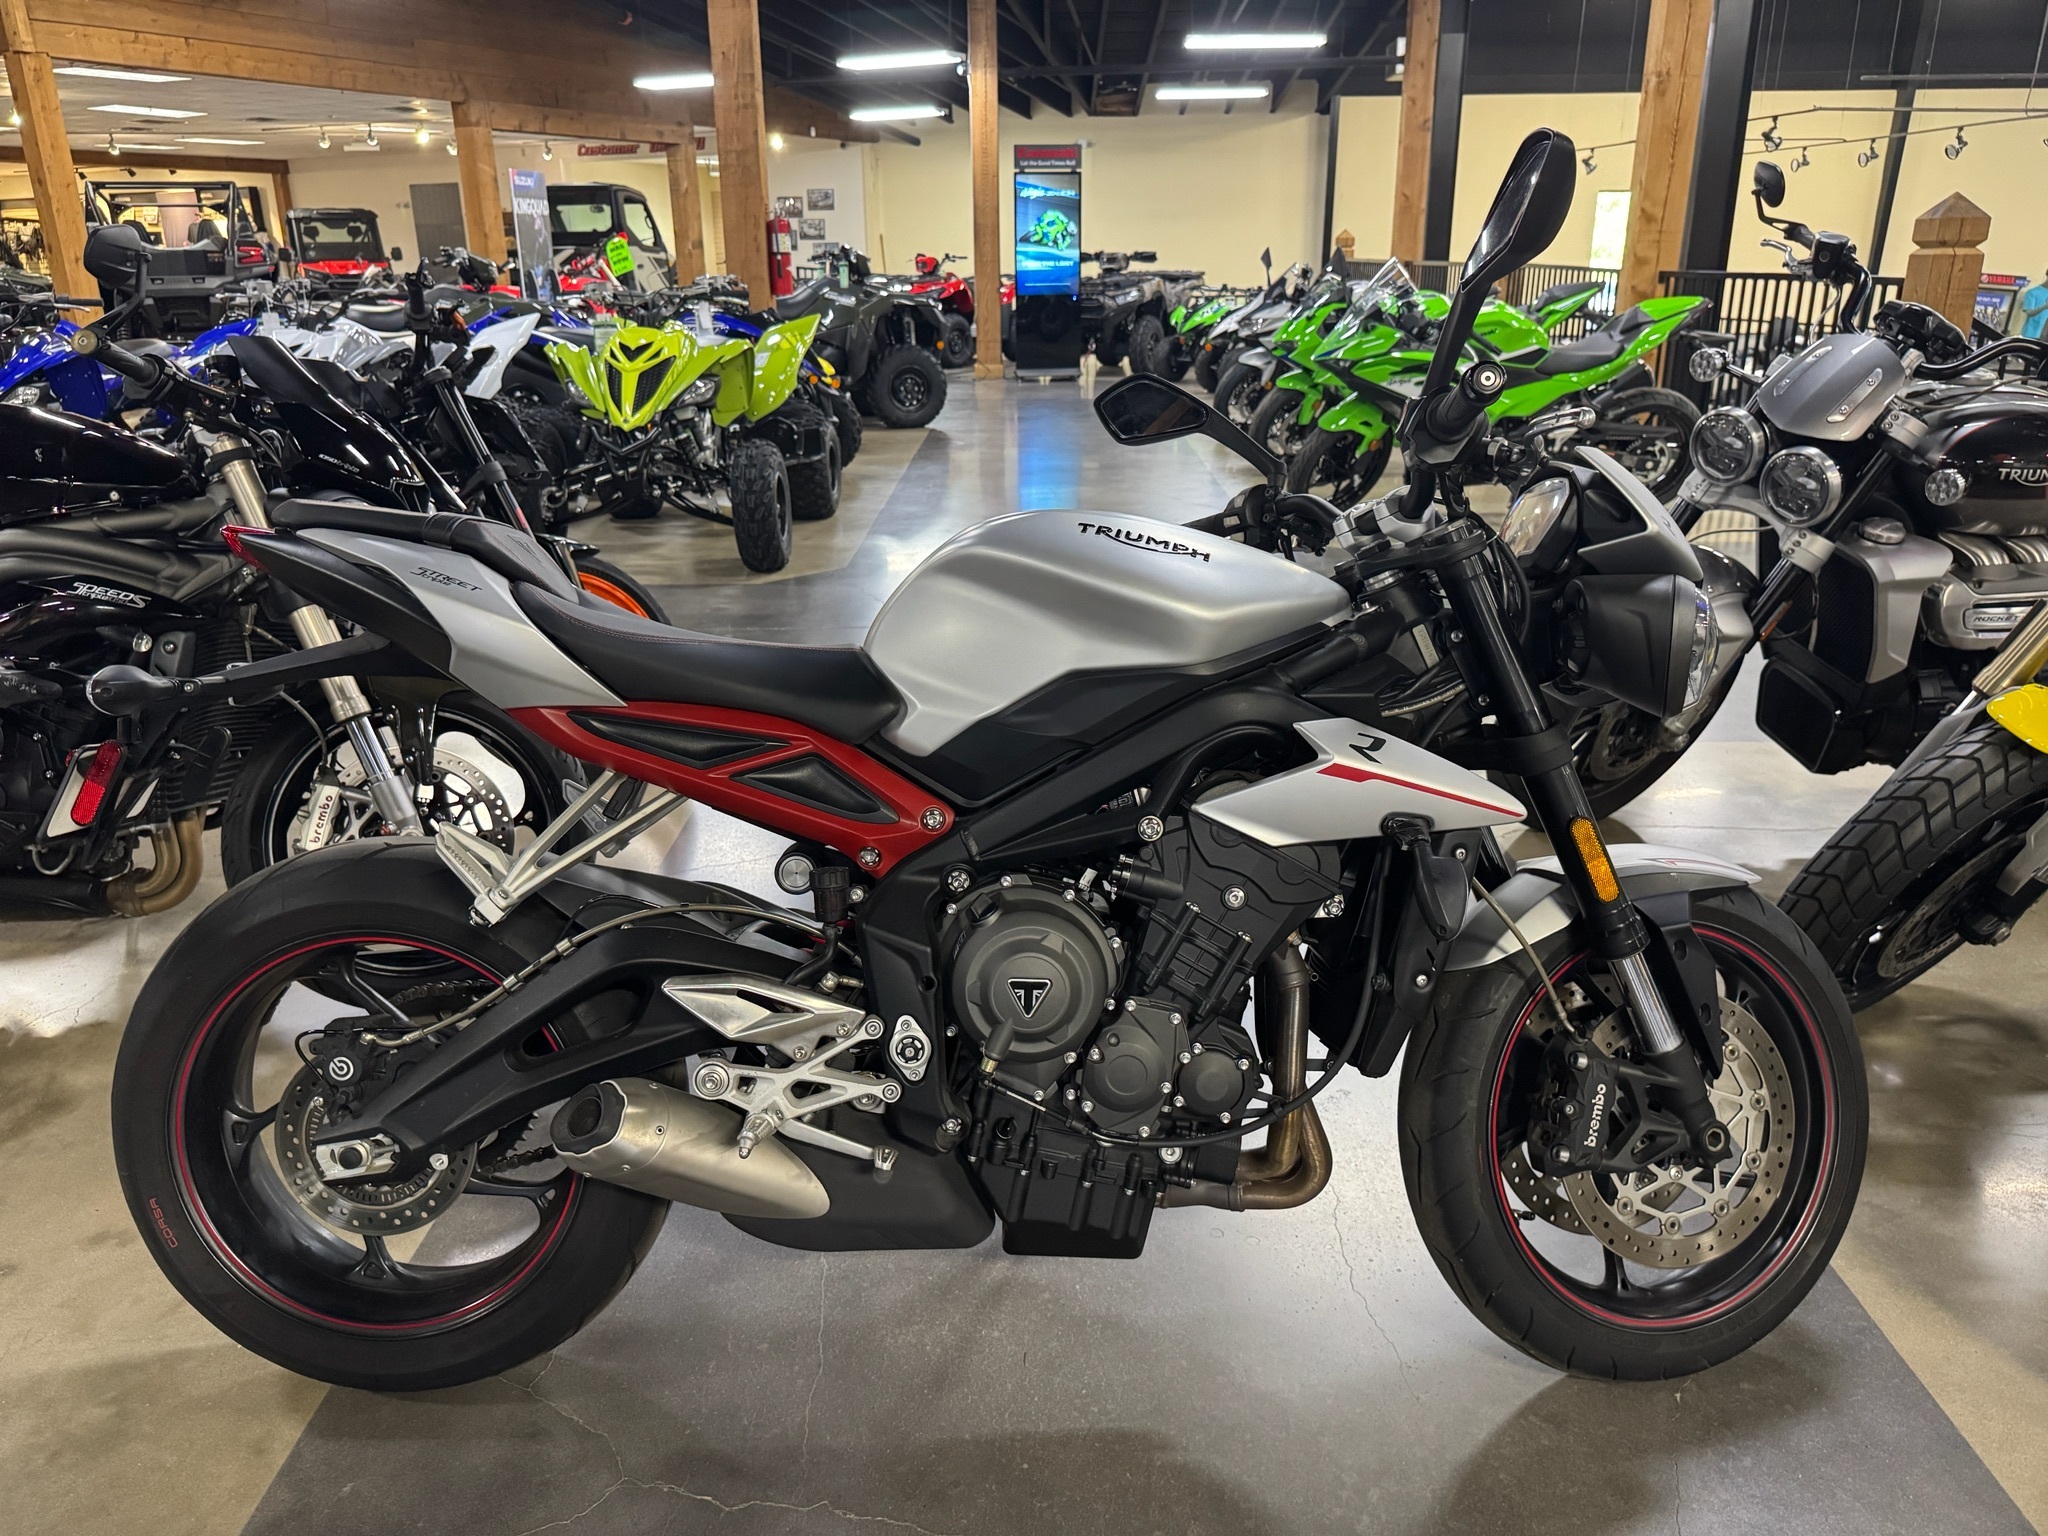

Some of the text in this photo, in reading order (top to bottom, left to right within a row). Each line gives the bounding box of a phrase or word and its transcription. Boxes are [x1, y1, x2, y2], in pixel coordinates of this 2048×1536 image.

[1077, 522, 1211, 562] TRIUMPH
[410, 566, 483, 591] STREET
[309, 795, 333, 843] brembo
[1583, 1083, 1607, 1148] brembo
[149, 1197, 179, 1248] CORSA
